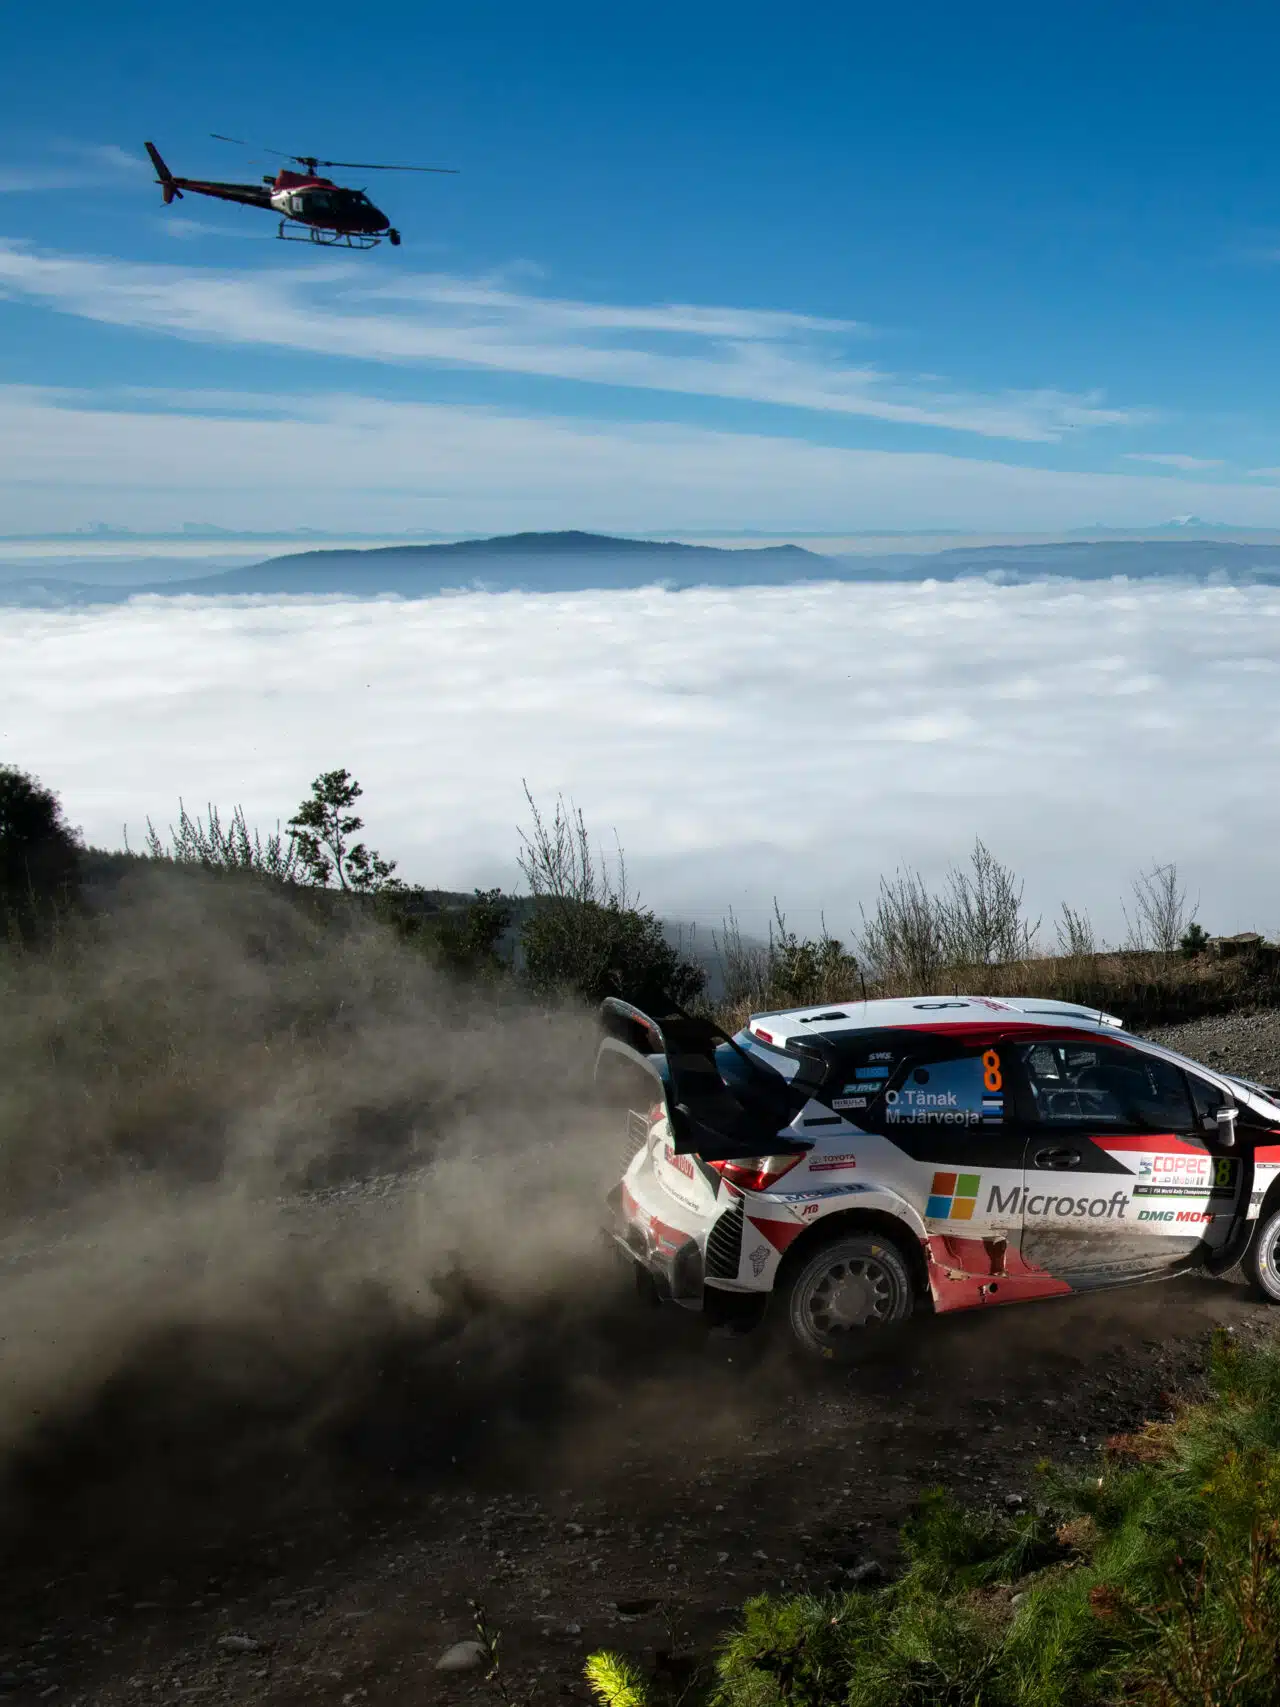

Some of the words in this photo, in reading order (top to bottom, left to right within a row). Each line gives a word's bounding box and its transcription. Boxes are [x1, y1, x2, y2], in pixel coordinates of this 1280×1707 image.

[913, 1002, 970, 1010] 8
[982, 1050, 1002, 1092] 8
[885, 1090, 957, 1106] O.Tänak
[886, 1108, 980, 1127] M.Järveoja
[823, 1154, 855, 1162] TOYOTA
[1216, 1159, 1231, 1186] 8
[802, 1204, 819, 1216] JTB
[986, 1185, 1130, 1219] Microsoft
[1137, 1210, 1175, 1222] DMG
